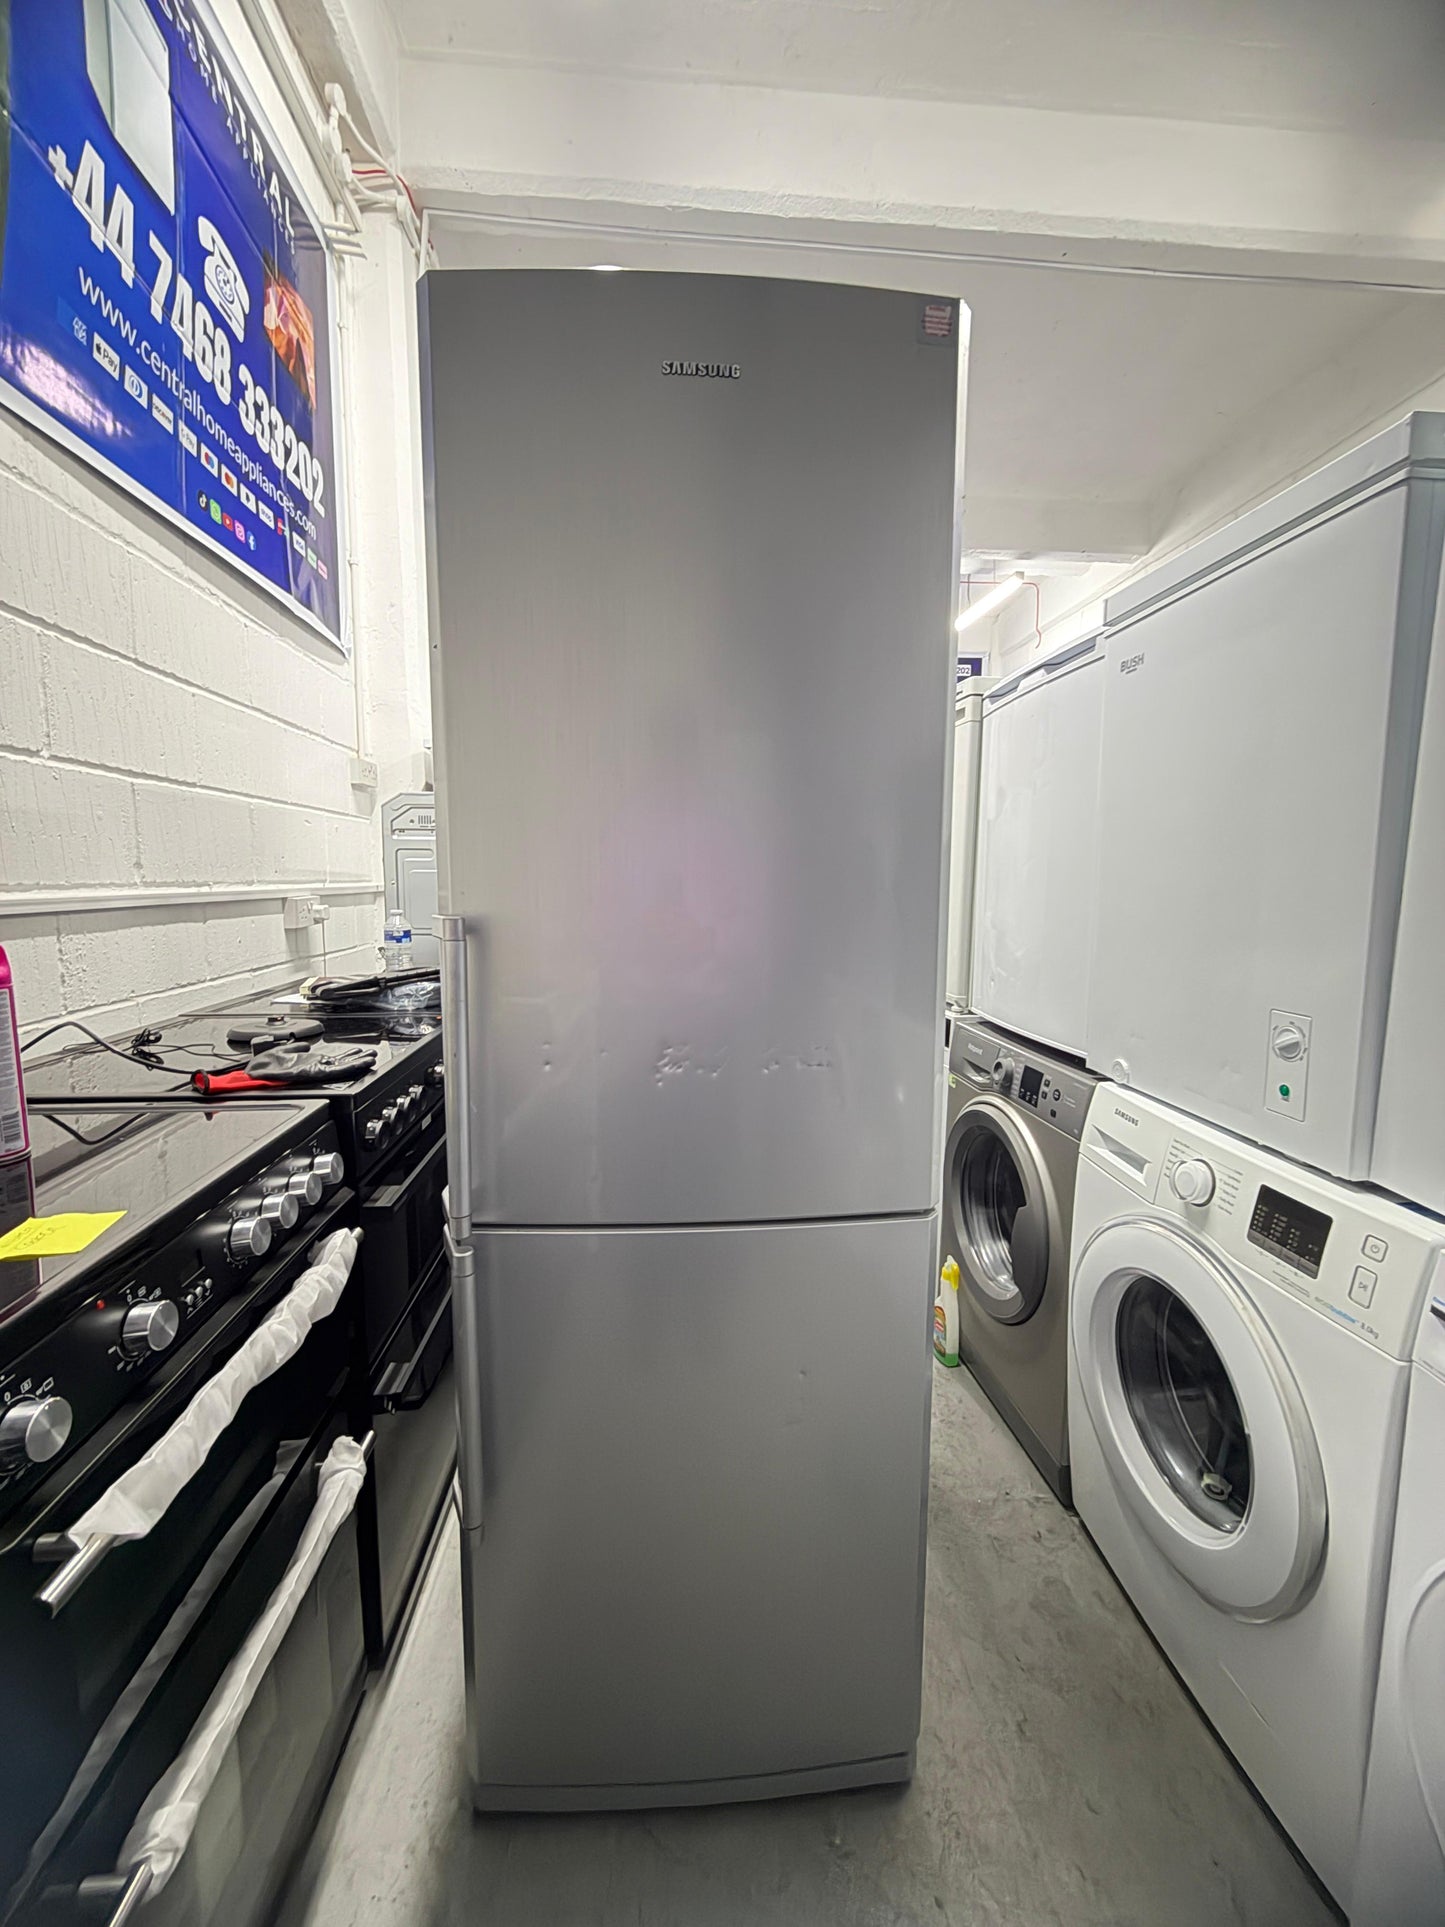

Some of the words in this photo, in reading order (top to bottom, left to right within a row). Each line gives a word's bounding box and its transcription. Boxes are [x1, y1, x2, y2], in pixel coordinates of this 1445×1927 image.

[48, 139, 135, 289] +44
[149, 229, 232, 406] 7468
[238, 364, 326, 519] 333202
[661, 360, 741, 379] SAMSUNG
[78, 266, 317, 541] www.centralhomeappliances.com
[1120, 652, 1145, 673] BUSH
[1113, 1107, 1140, 1127] SAMSUNG
